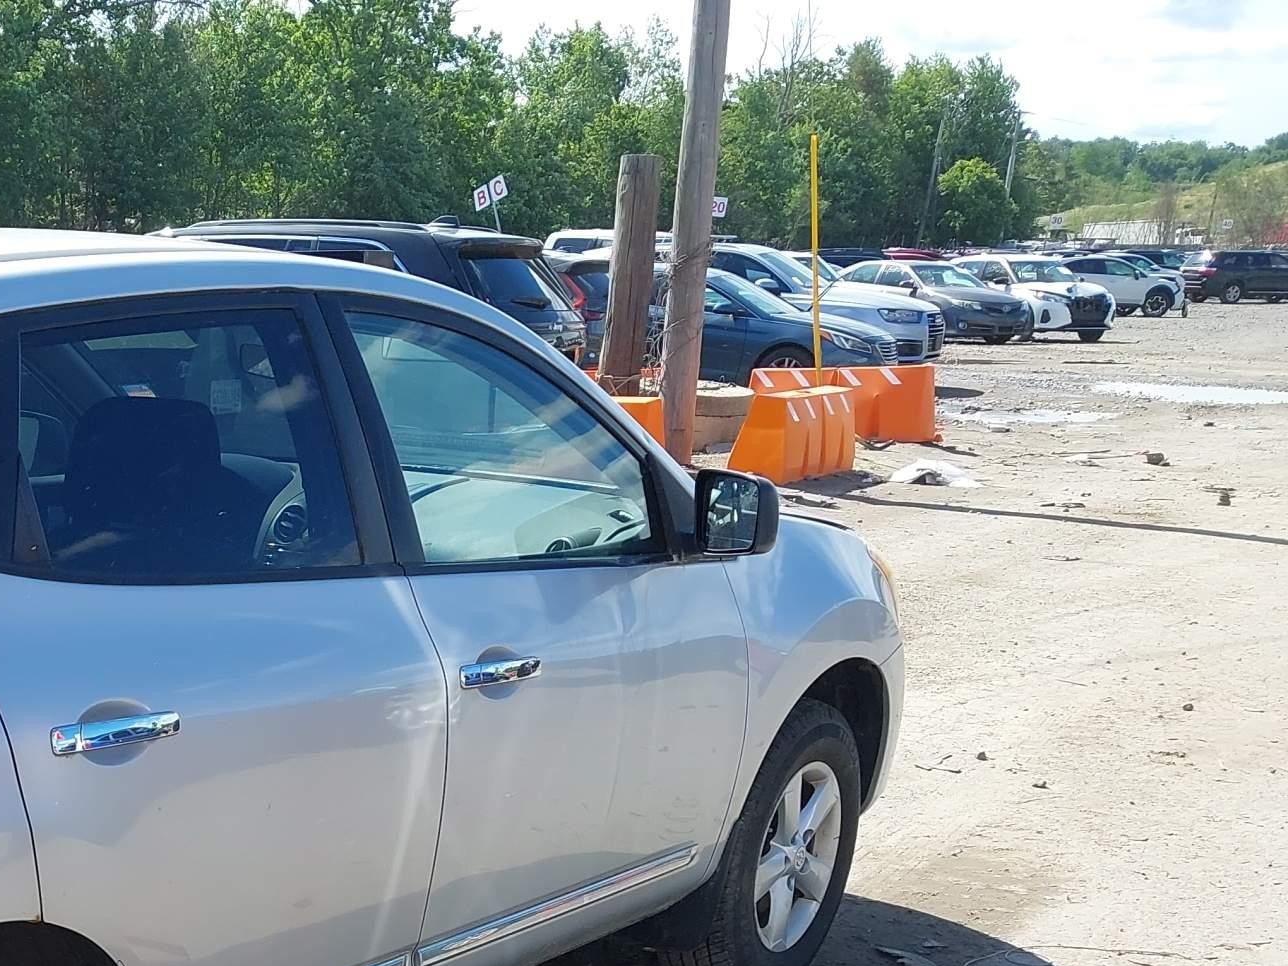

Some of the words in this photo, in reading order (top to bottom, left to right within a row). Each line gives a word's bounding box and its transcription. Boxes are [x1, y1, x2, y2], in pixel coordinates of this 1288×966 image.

[493, 180, 504, 196] C
[477, 190, 487, 207] B
[712, 201, 725, 213] 20
[1051, 216, 1063, 225] 30
